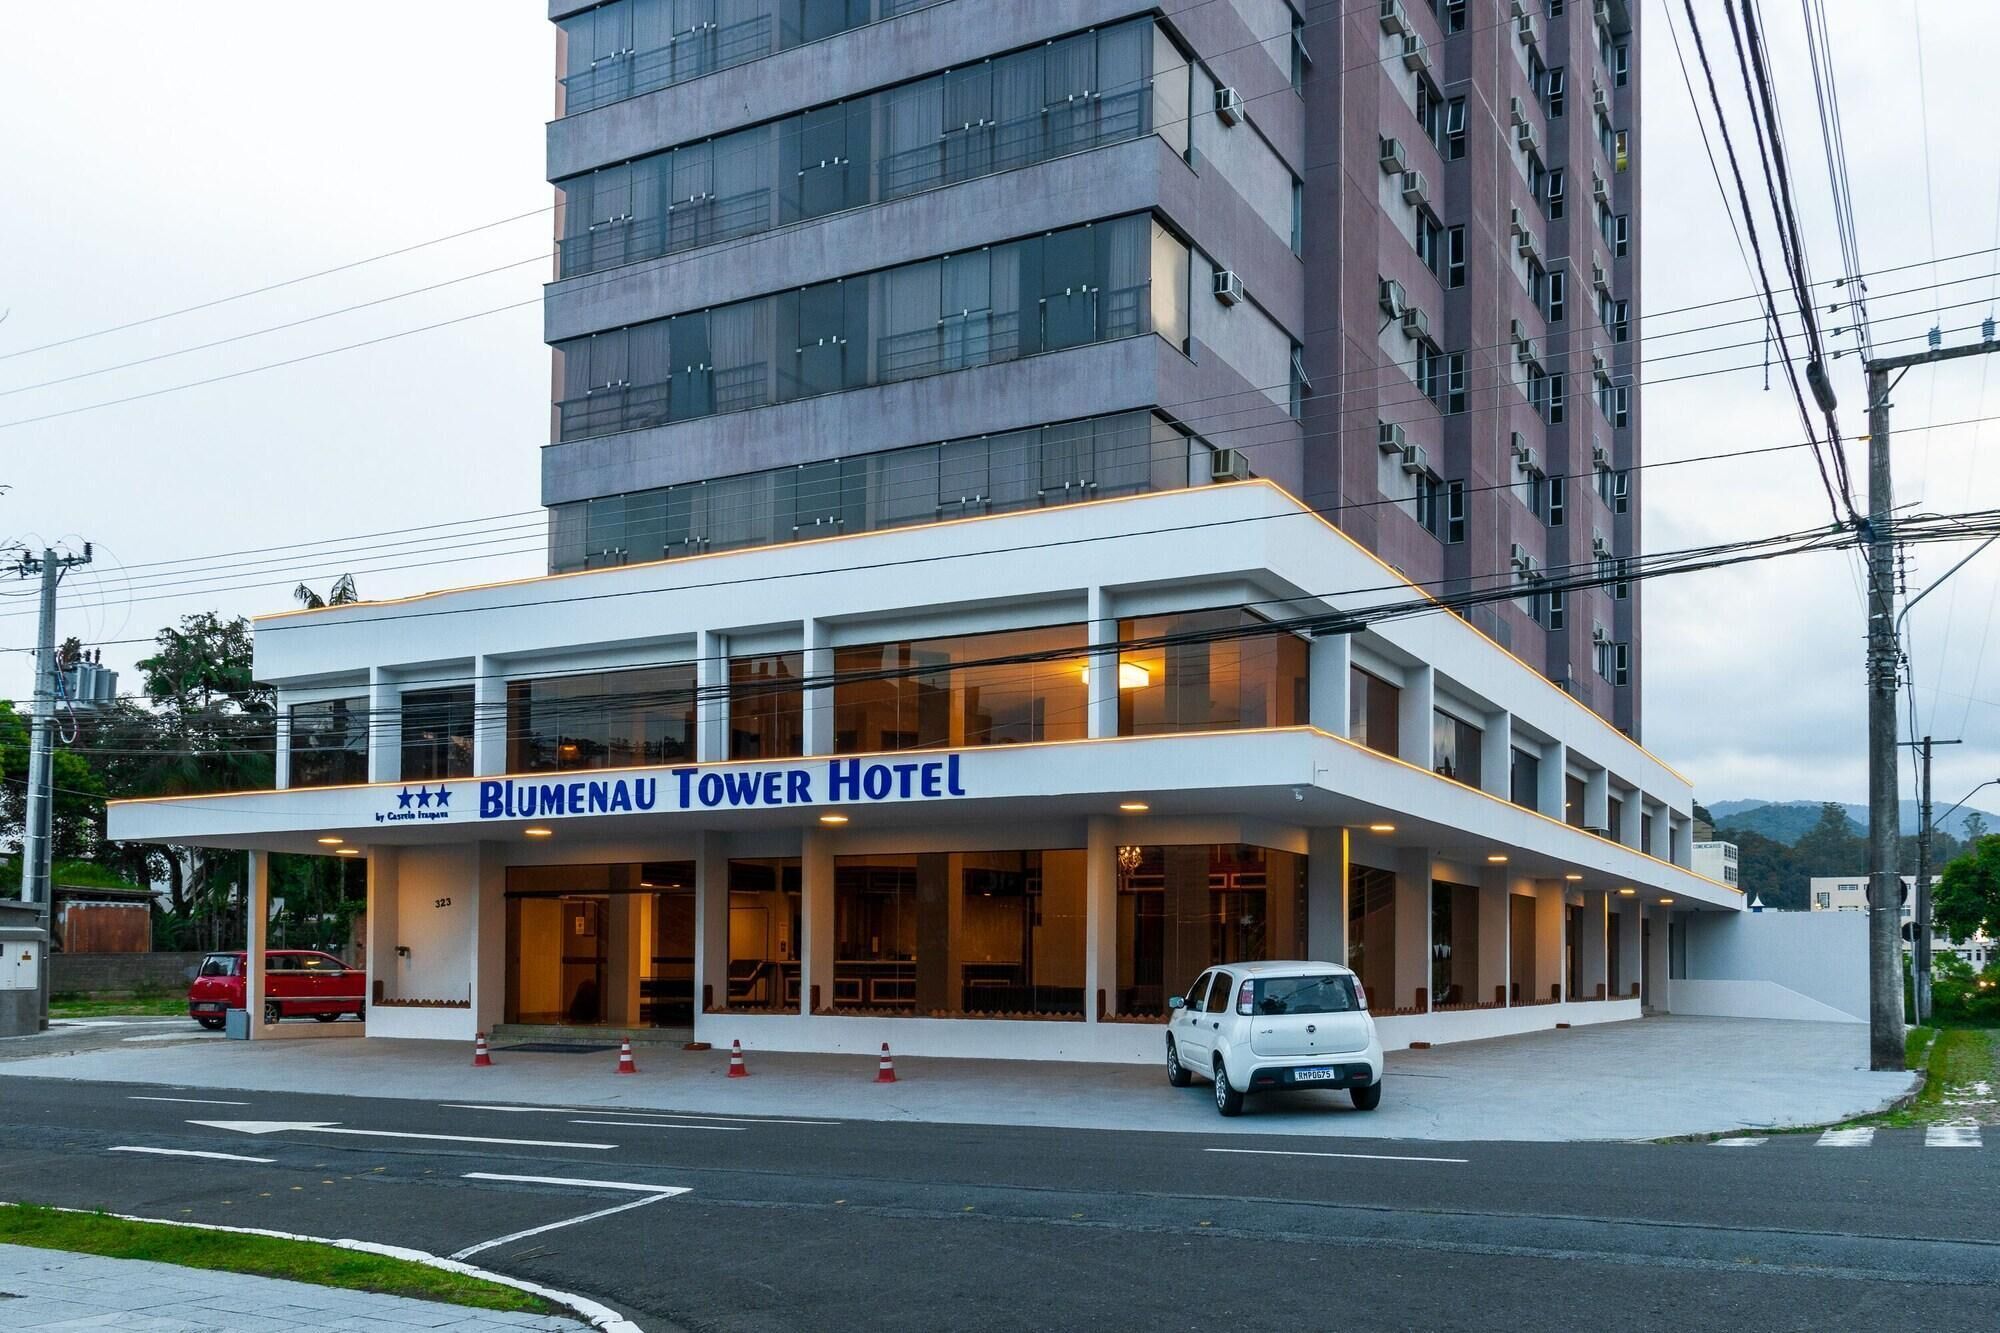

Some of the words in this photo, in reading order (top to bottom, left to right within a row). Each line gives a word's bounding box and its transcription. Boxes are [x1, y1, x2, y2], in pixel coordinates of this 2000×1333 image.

[479, 777, 657, 819] BLUMENAU
[671, 767, 813, 809] TOWER
[828, 753, 966, 802] HOTEL
[375, 812, 385, 823] by
[434, 897, 452, 909] 323
